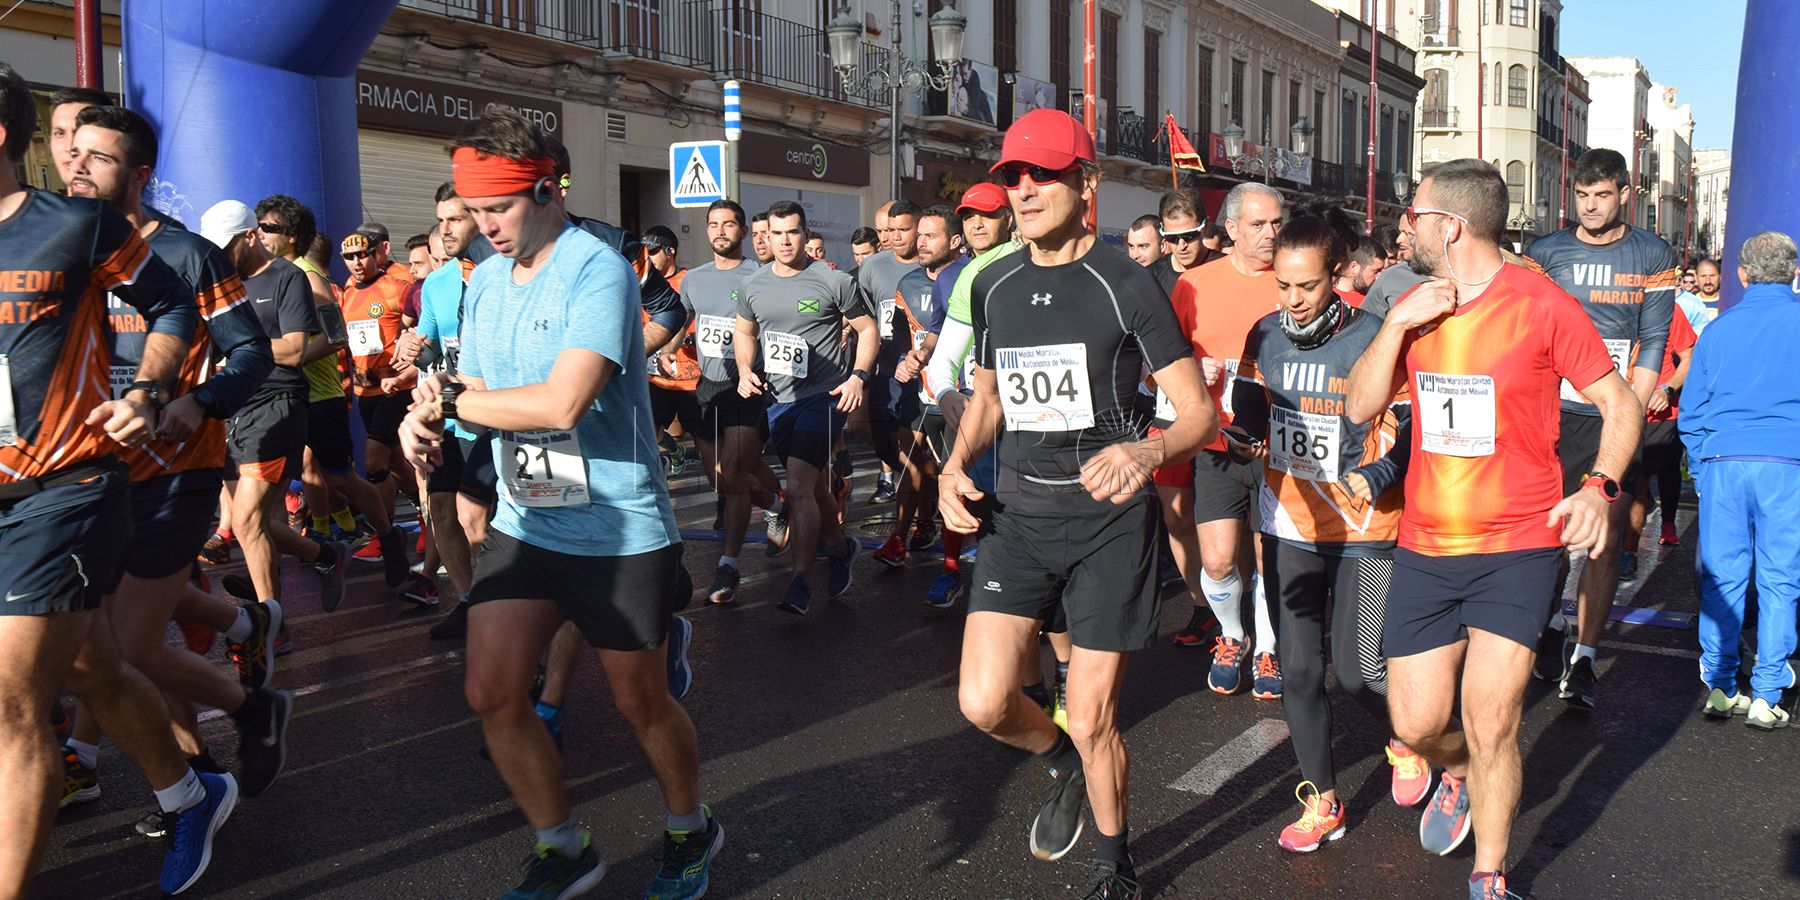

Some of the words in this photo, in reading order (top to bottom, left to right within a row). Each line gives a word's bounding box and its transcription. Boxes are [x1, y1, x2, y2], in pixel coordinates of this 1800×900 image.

[443, 95, 480, 120] DEL
[786, 149, 822, 168] centro
[1573, 264, 1612, 287] VIII
[359, 330, 367, 344] 3
[701, 327, 733, 346] 259
[770, 343, 804, 364] 258
[999, 350, 1019, 369] VIII
[1008, 369, 1079, 405] 304
[1283, 362, 1326, 393] VIII
[1272, 405, 1286, 424] VIII
[1442, 397, 1454, 429] 1
[1276, 426, 1329, 461] 185
[514, 446, 554, 480] 21
